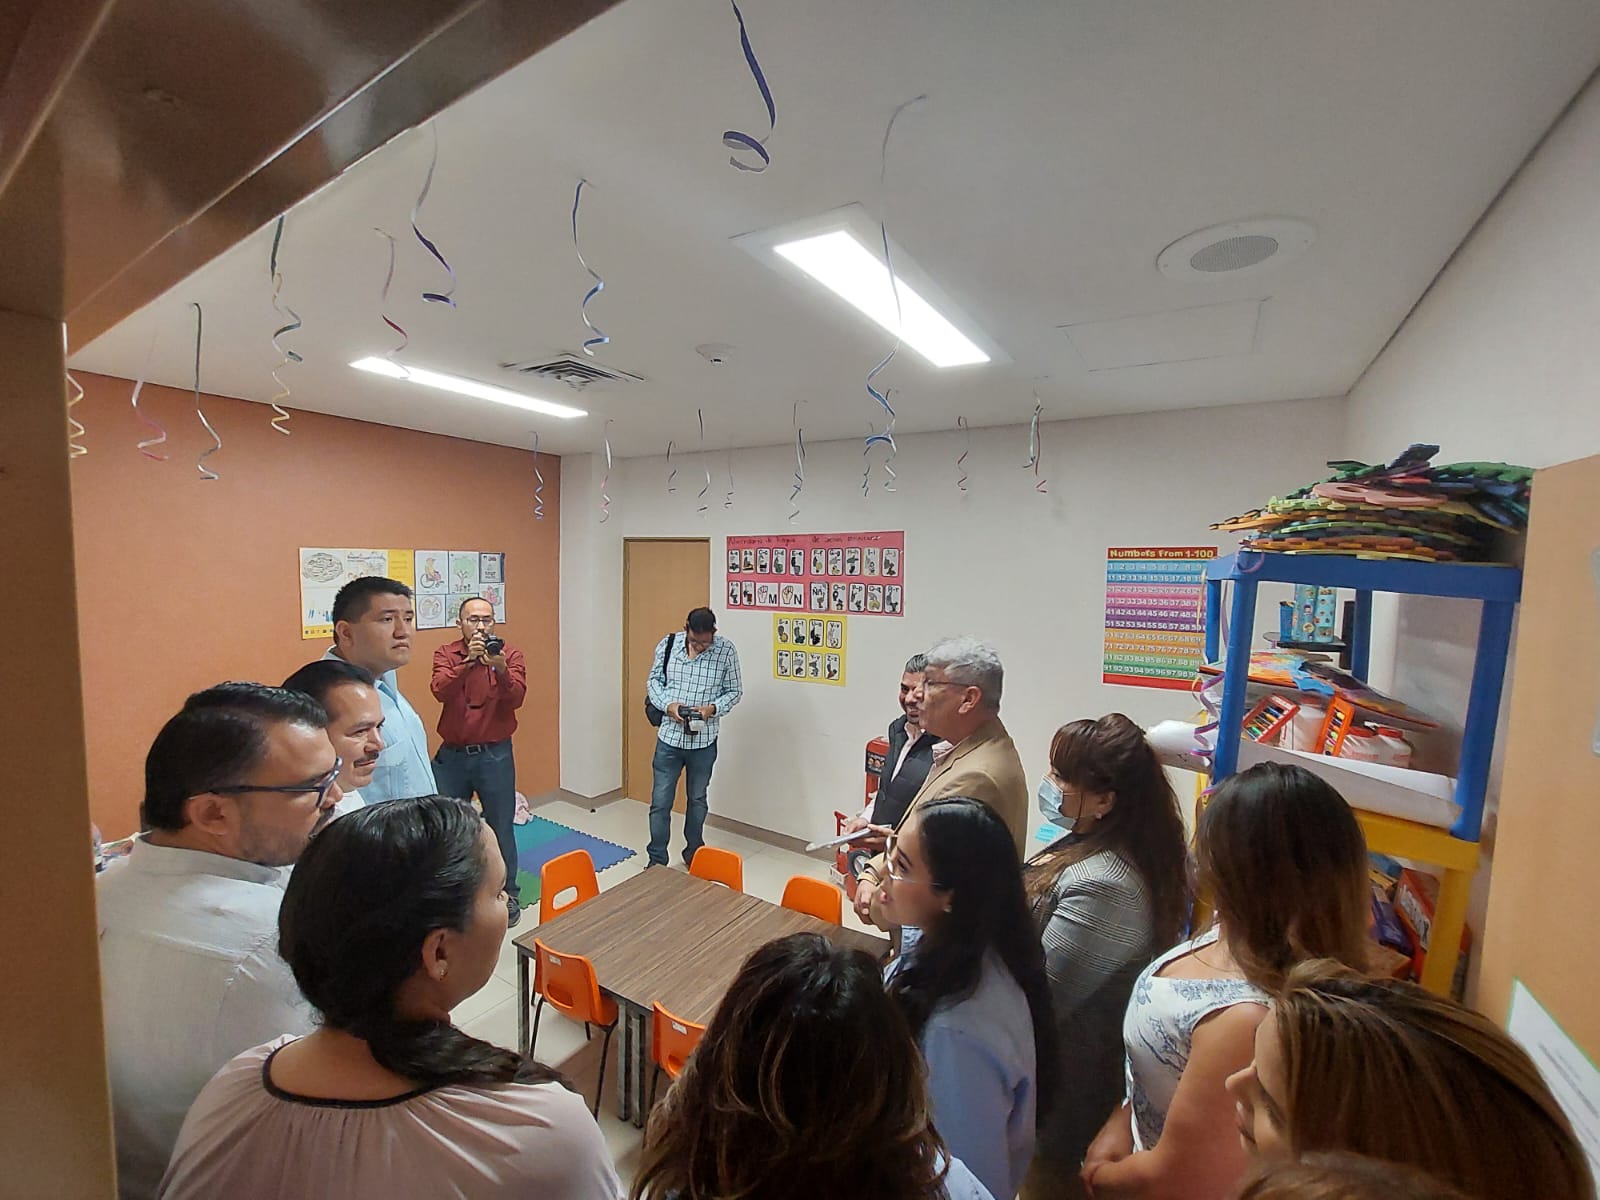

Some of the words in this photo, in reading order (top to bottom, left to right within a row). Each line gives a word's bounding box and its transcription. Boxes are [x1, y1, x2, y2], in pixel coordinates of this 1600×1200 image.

[1110, 549, 1156, 558] Numbers
[1185, 549, 1214, 558] 1-100
[768, 593, 777, 604] M
[794, 593, 802, 605] N
